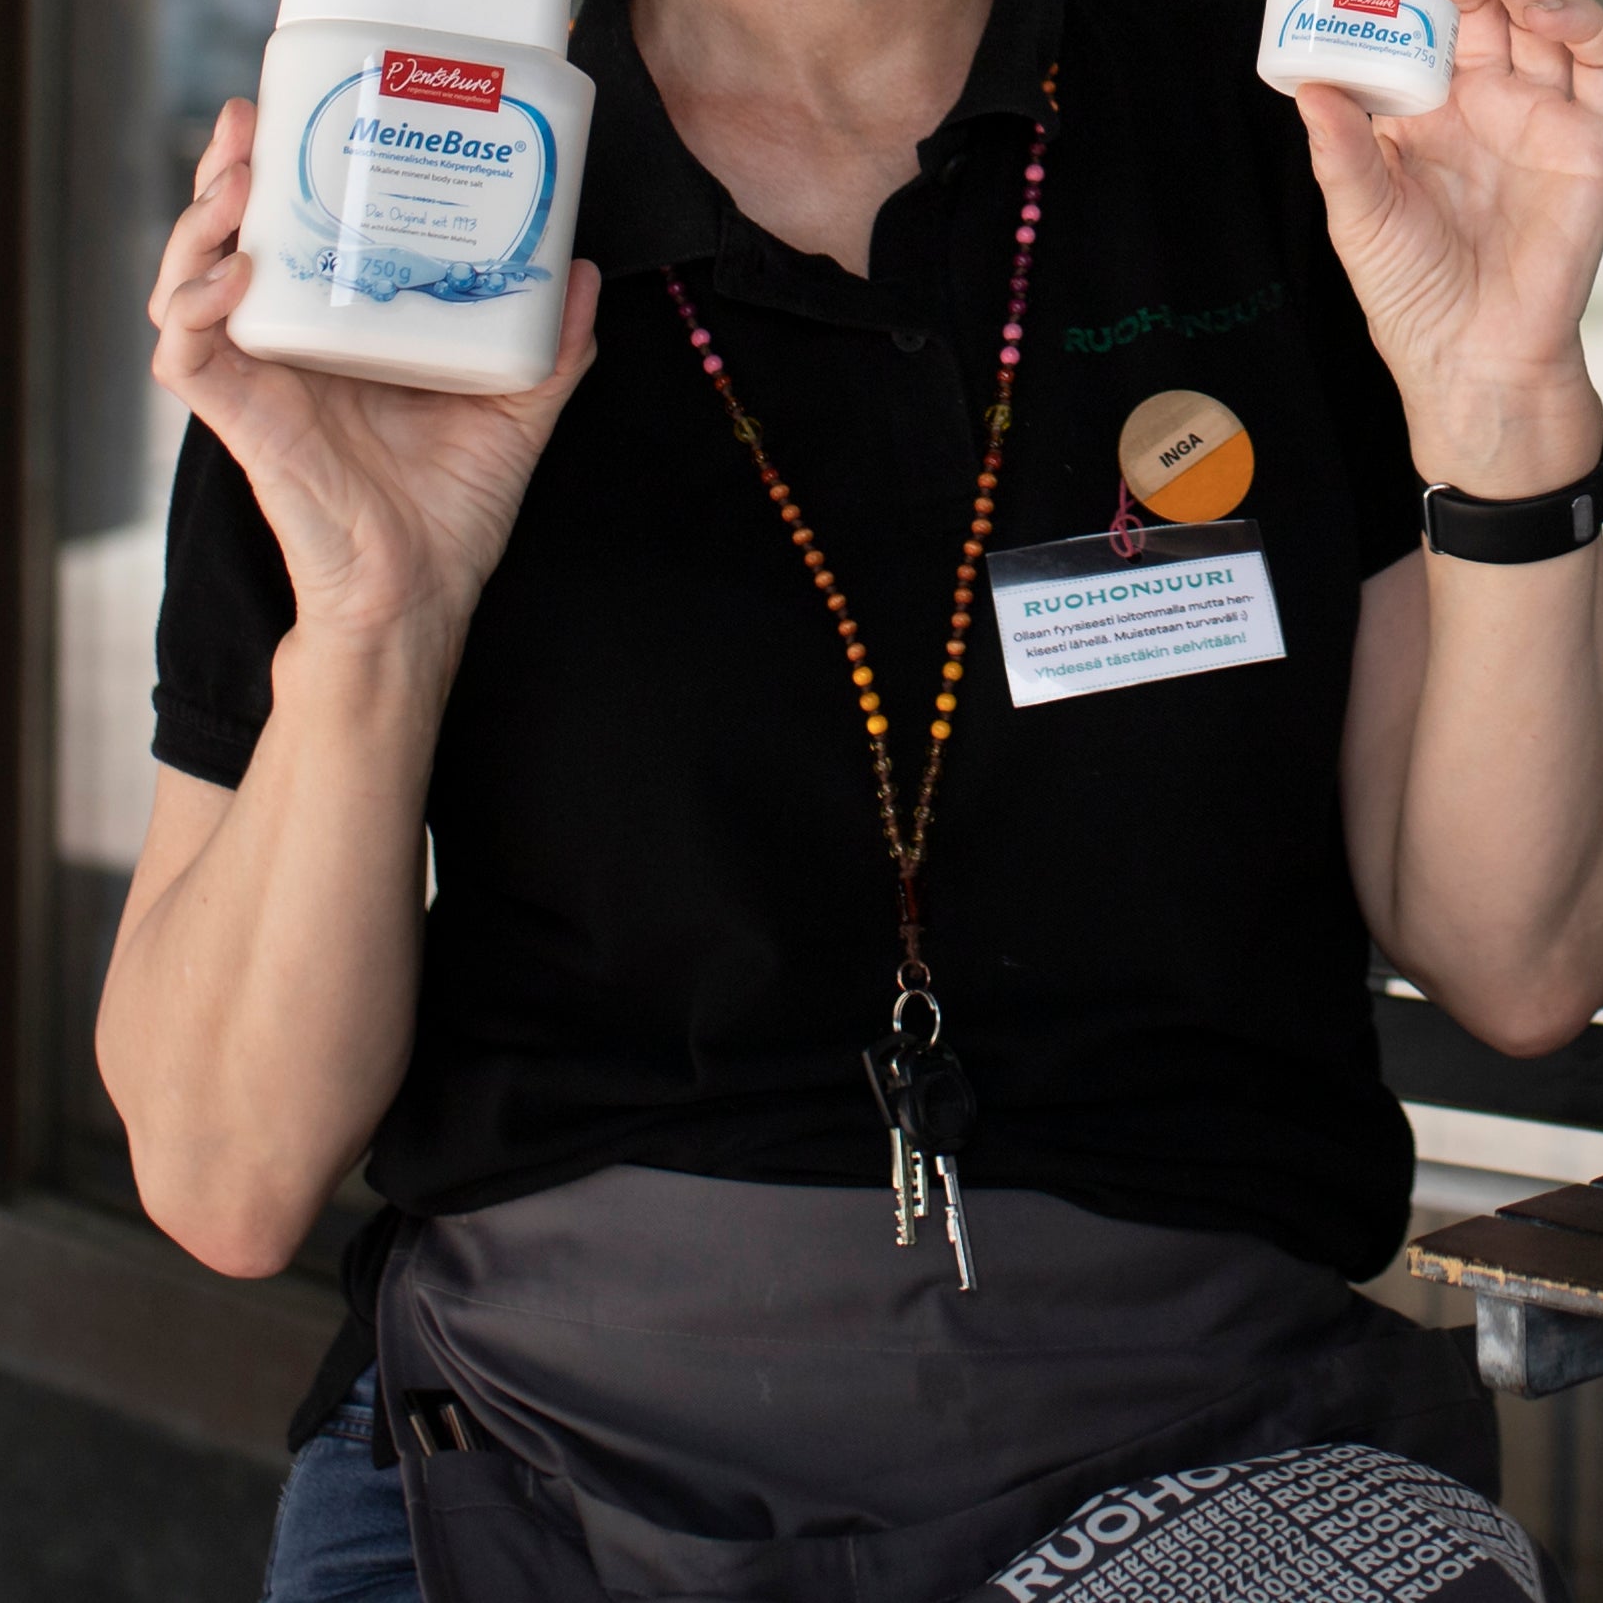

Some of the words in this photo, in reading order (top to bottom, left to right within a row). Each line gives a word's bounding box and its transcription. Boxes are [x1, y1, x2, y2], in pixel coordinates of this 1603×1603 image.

[1414, 47, 1435, 68] 75g
[401, 167, 431, 180] mineral
[430, 171, 452, 185] body
[452, 177, 469, 186] care
[469, 178, 484, 188] salt
[439, 158, 514, 180] Körperpflegesalz
[362, 258, 394, 278] 750
[399, 266, 412, 284] g
[1158, 432, 1204, 469] INGA
[1023, 568, 1234, 617] RUOHONJUURI
[1187, 596, 1224, 612] mutta
[1225, 591, 1255, 606] hen-
[1024, 640, 1067, 658] kisesti
[1113, 620, 1183, 643] Muistetaan
[1034, 655, 1102, 680] Yhdessä
[1104, 643, 1170, 667] tästäkin
[1171, 630, 1247, 655] selvitään!
